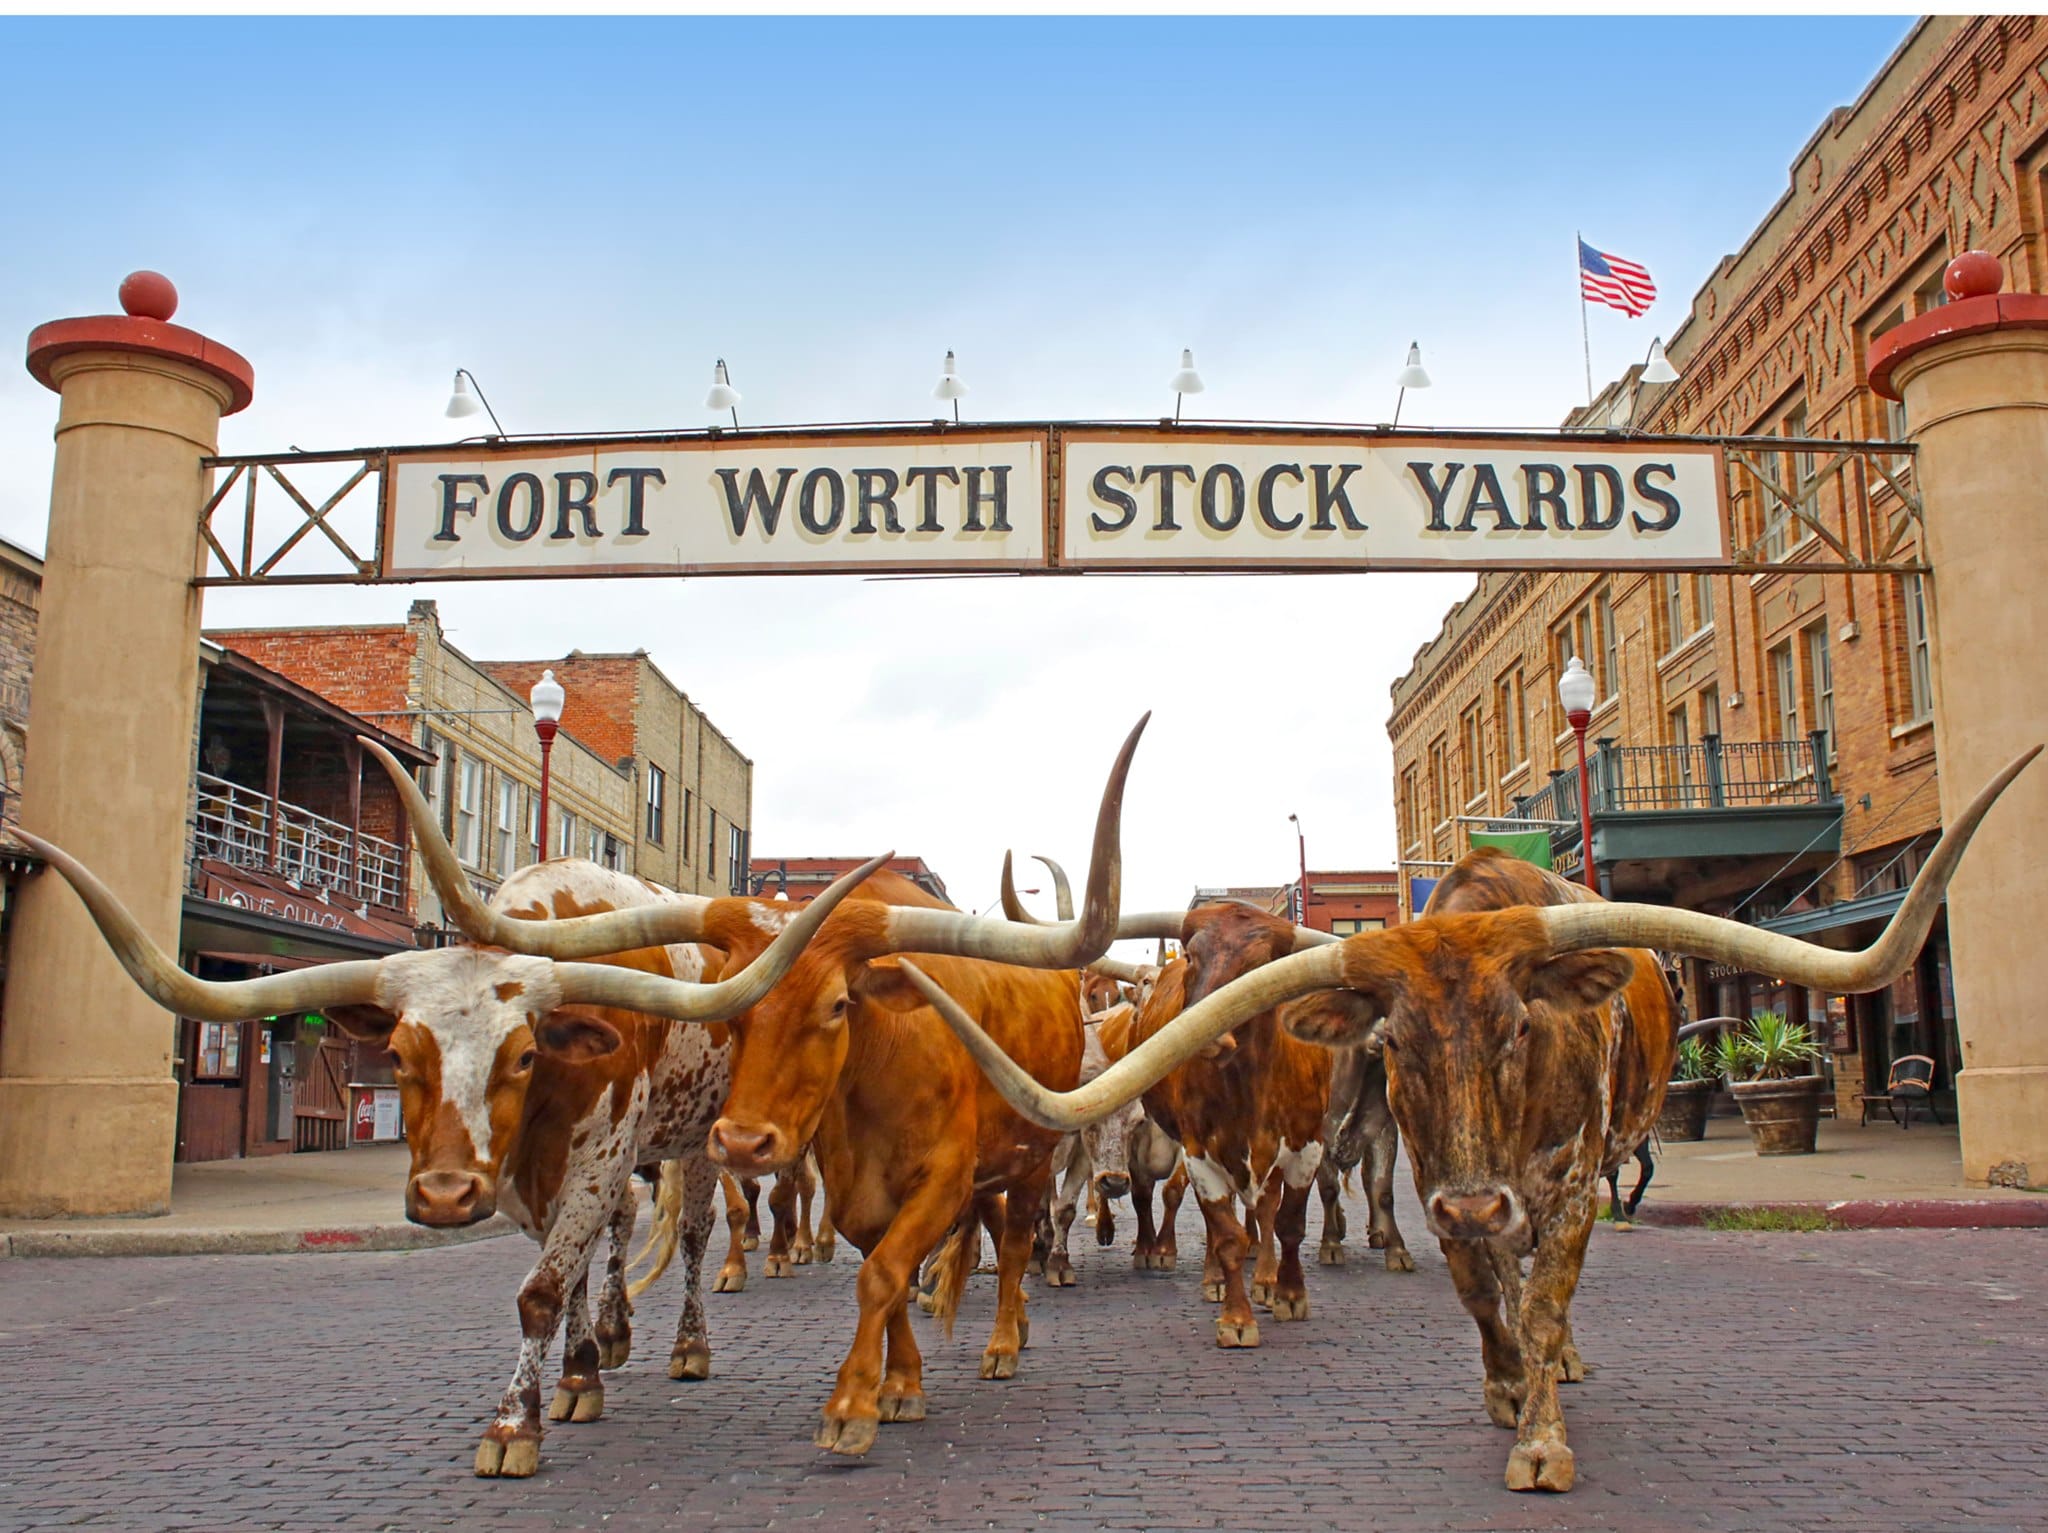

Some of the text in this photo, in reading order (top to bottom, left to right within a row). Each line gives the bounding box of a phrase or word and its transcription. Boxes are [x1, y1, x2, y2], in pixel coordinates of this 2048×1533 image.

[433, 462, 1681, 542] FORT WORTH STOCK YARDS
